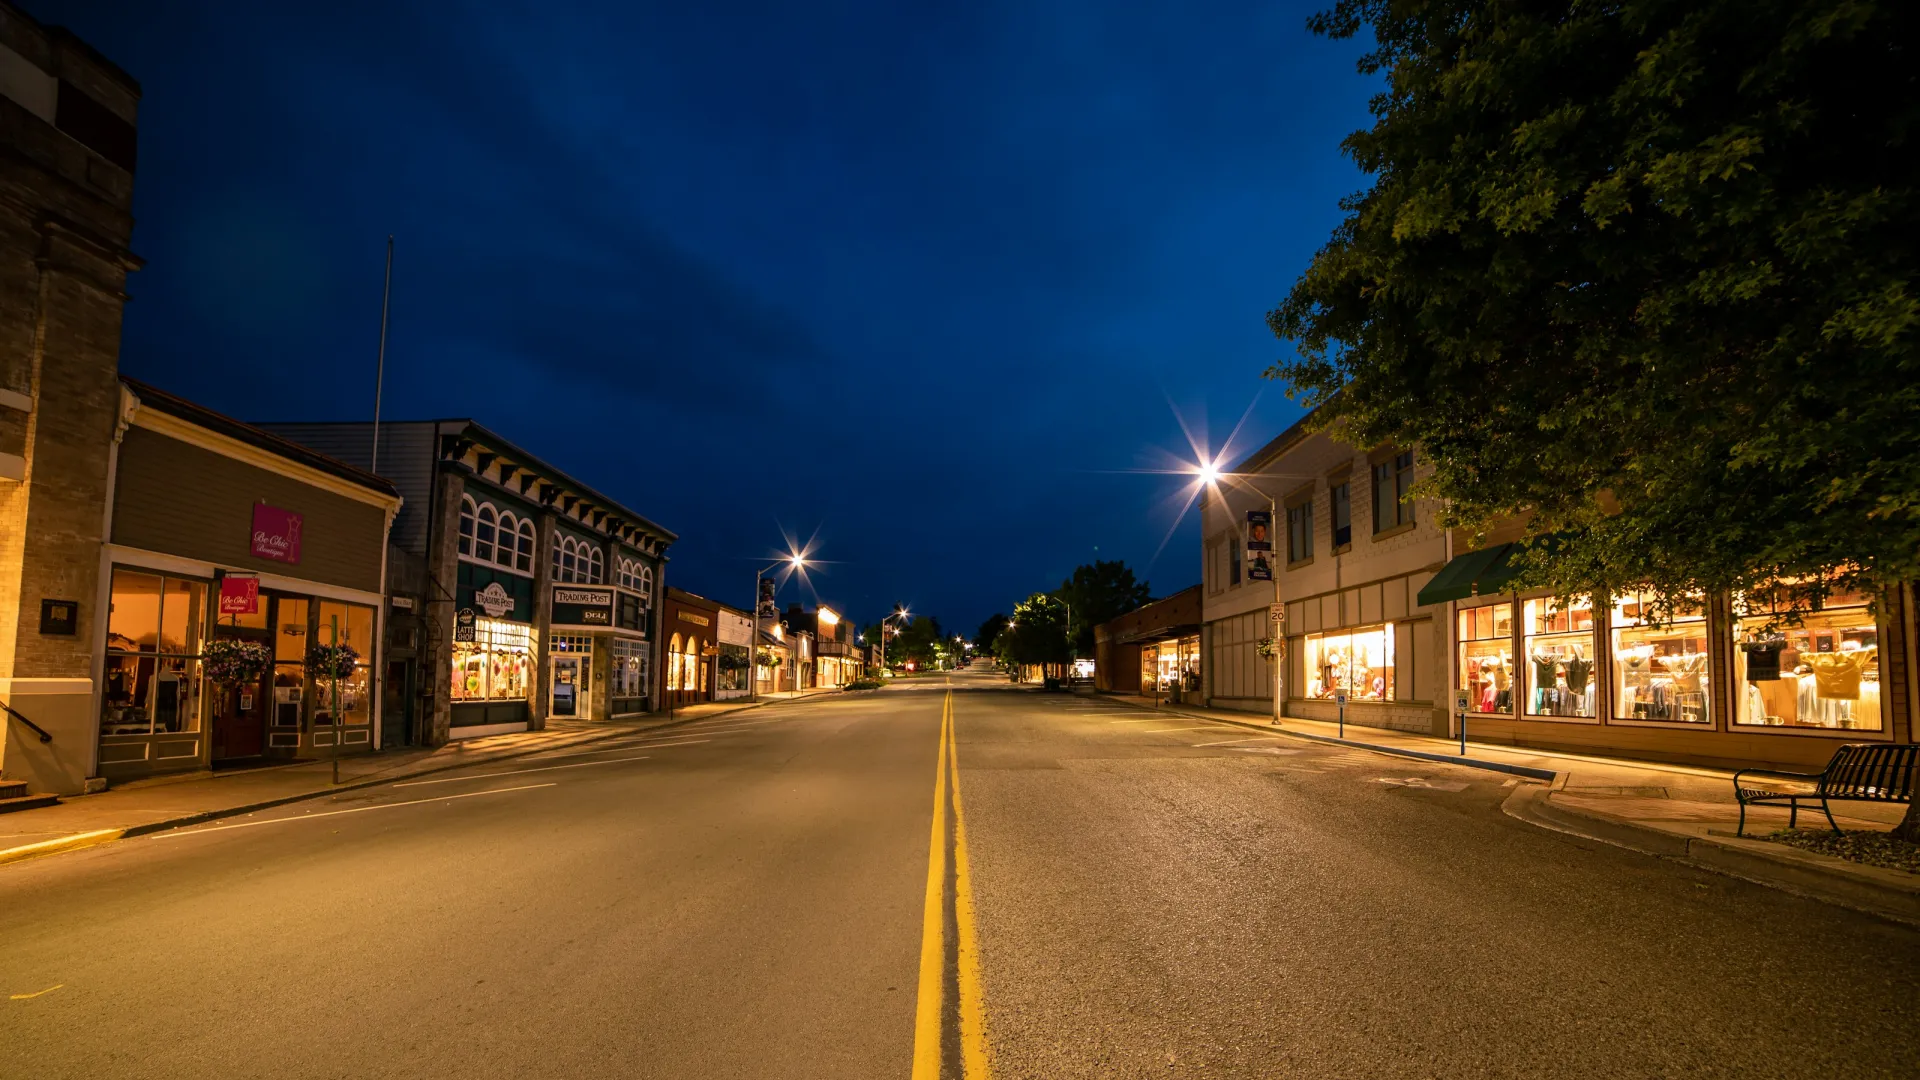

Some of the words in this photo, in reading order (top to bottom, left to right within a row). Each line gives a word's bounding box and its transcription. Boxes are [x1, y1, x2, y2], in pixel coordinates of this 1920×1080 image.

[254, 531, 269, 543] Be
[270, 535, 288, 548] Chic
[256, 544, 285, 557] Boutique
[222, 595, 233, 604] Be
[233, 596, 248, 604] Chic
[501, 597, 513, 608] POST
[558, 592, 589, 602] TRADING
[590, 593, 609, 603] POST
[1271, 612, 1284, 620] 20
[457, 626, 474, 634] LATTE
[457, 634, 474, 642] SHOP
